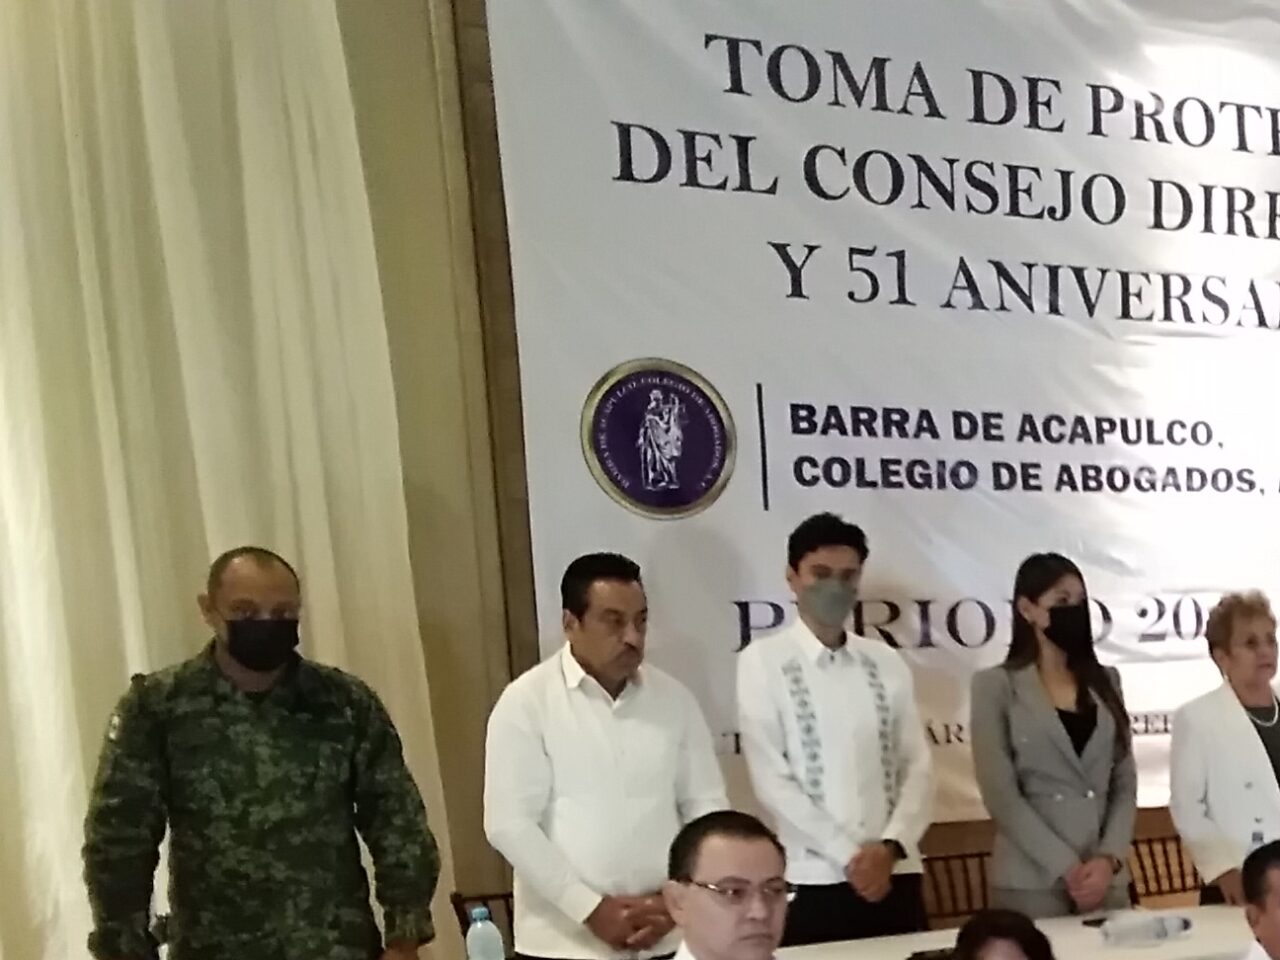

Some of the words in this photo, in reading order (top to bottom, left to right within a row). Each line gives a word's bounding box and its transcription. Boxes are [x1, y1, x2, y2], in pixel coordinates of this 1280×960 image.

[704, 32, 947, 121] TOMA
[966, 67, 1066, 134] DE
[610, 120, 780, 196] DEL
[803, 143, 1127, 226] CONSEJO
[767, 241, 821, 300] Y
[847, 246, 917, 307] 51
[789, 402, 941, 440] BARRA
[952, 409, 1005, 442] DE
[1016, 412, 1224, 449] ACAPULCO,
[792, 455, 979, 491] COLEGIO
[991, 461, 1044, 492] DE
[1054, 463, 1265, 496] ABOGADOS,
